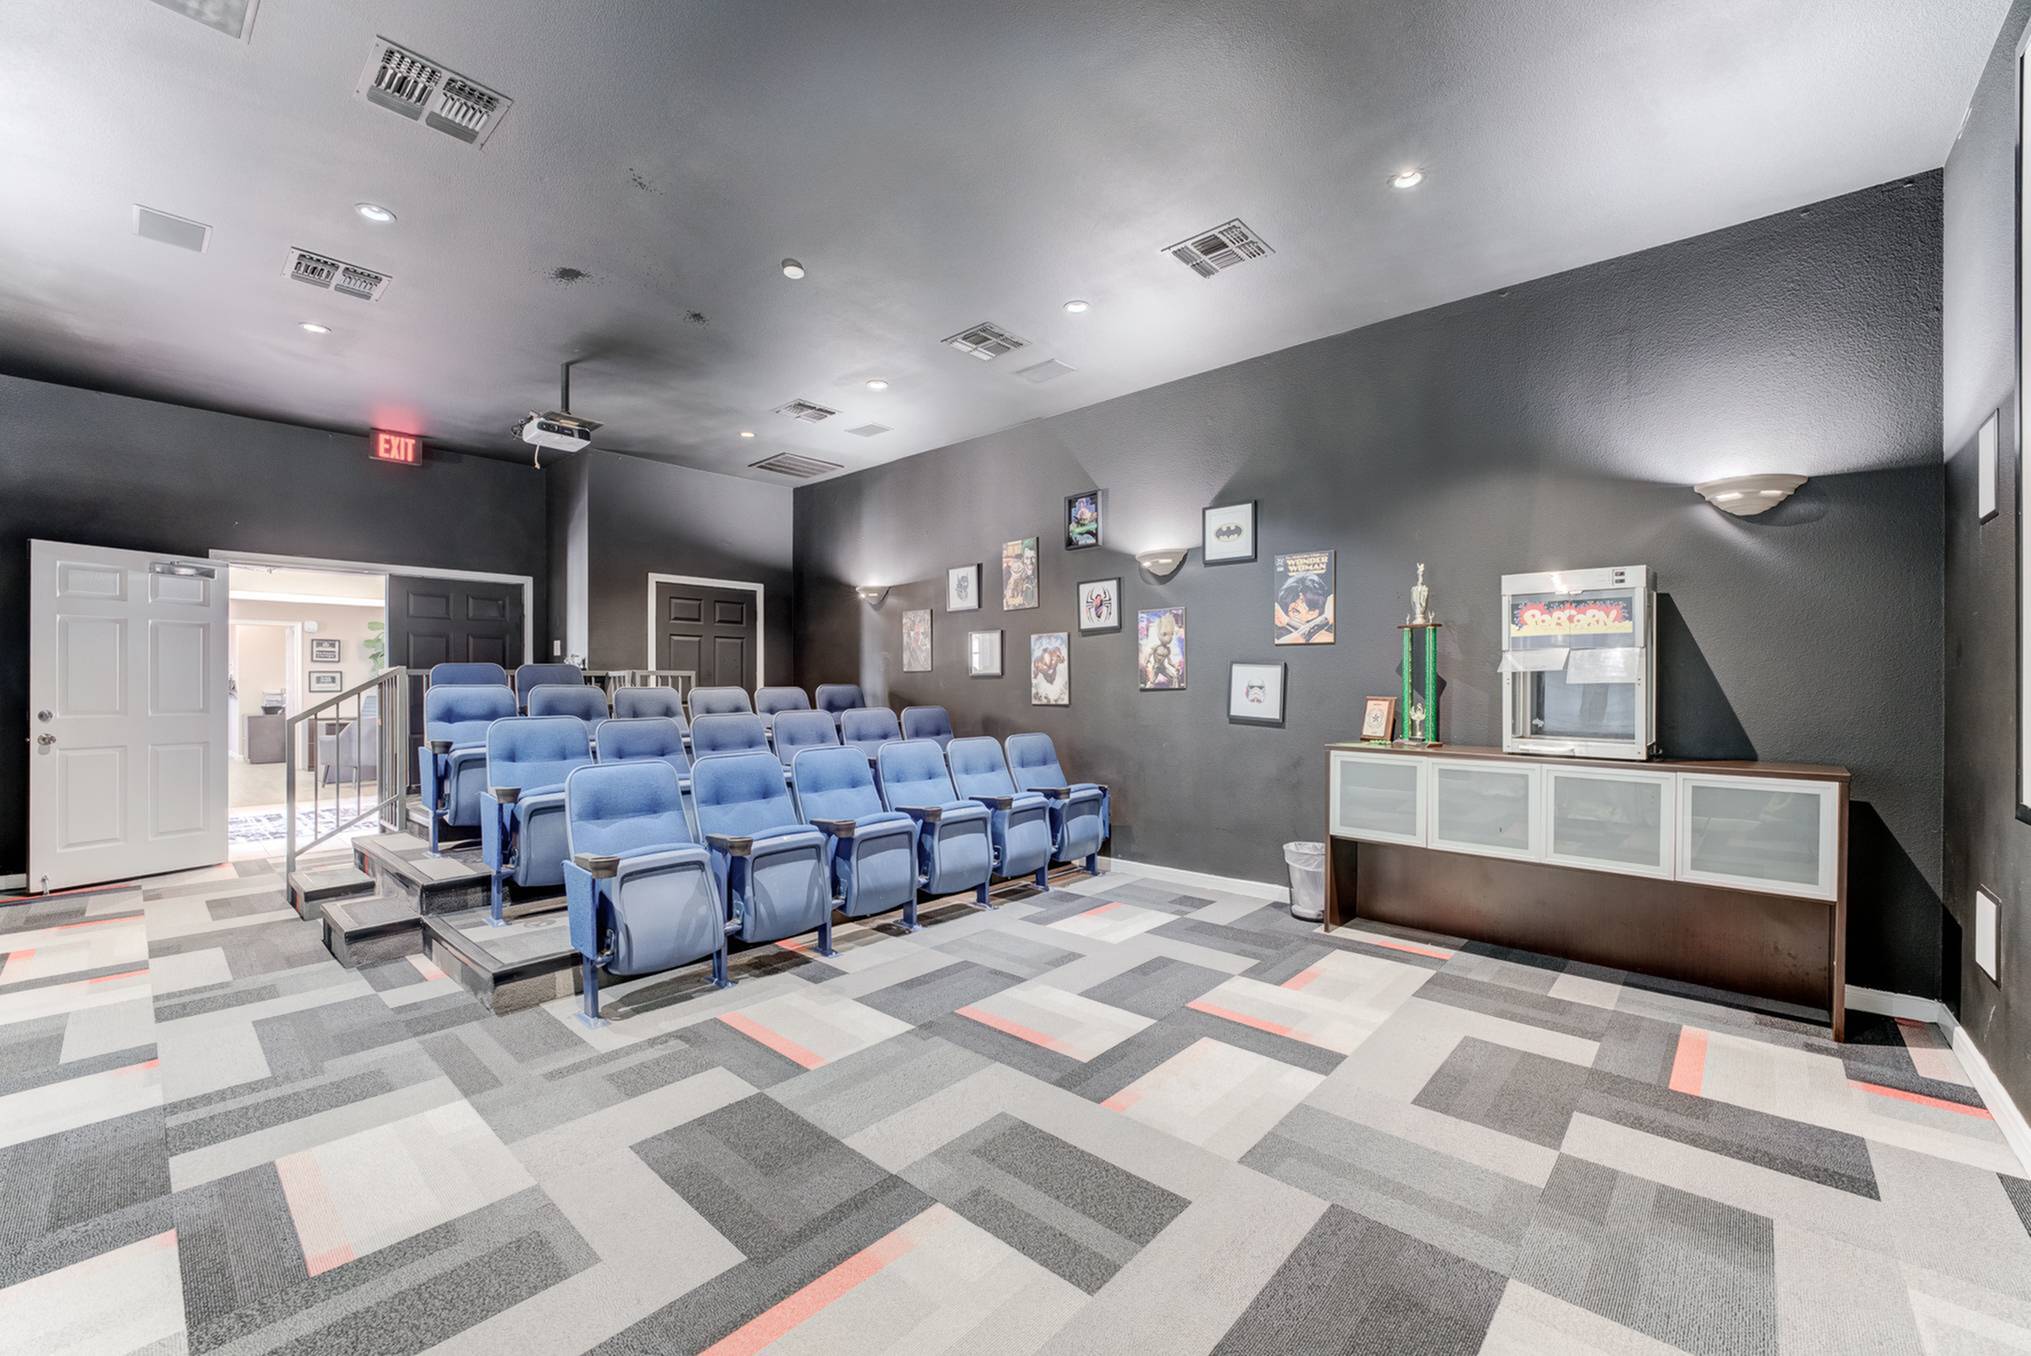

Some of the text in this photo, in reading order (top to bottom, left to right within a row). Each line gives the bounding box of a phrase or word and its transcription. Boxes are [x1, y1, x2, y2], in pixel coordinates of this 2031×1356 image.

[378, 433, 416, 462] EXIT
[1286, 556, 1328, 566] WONDER
[1288, 563, 1326, 573] WOMAN
